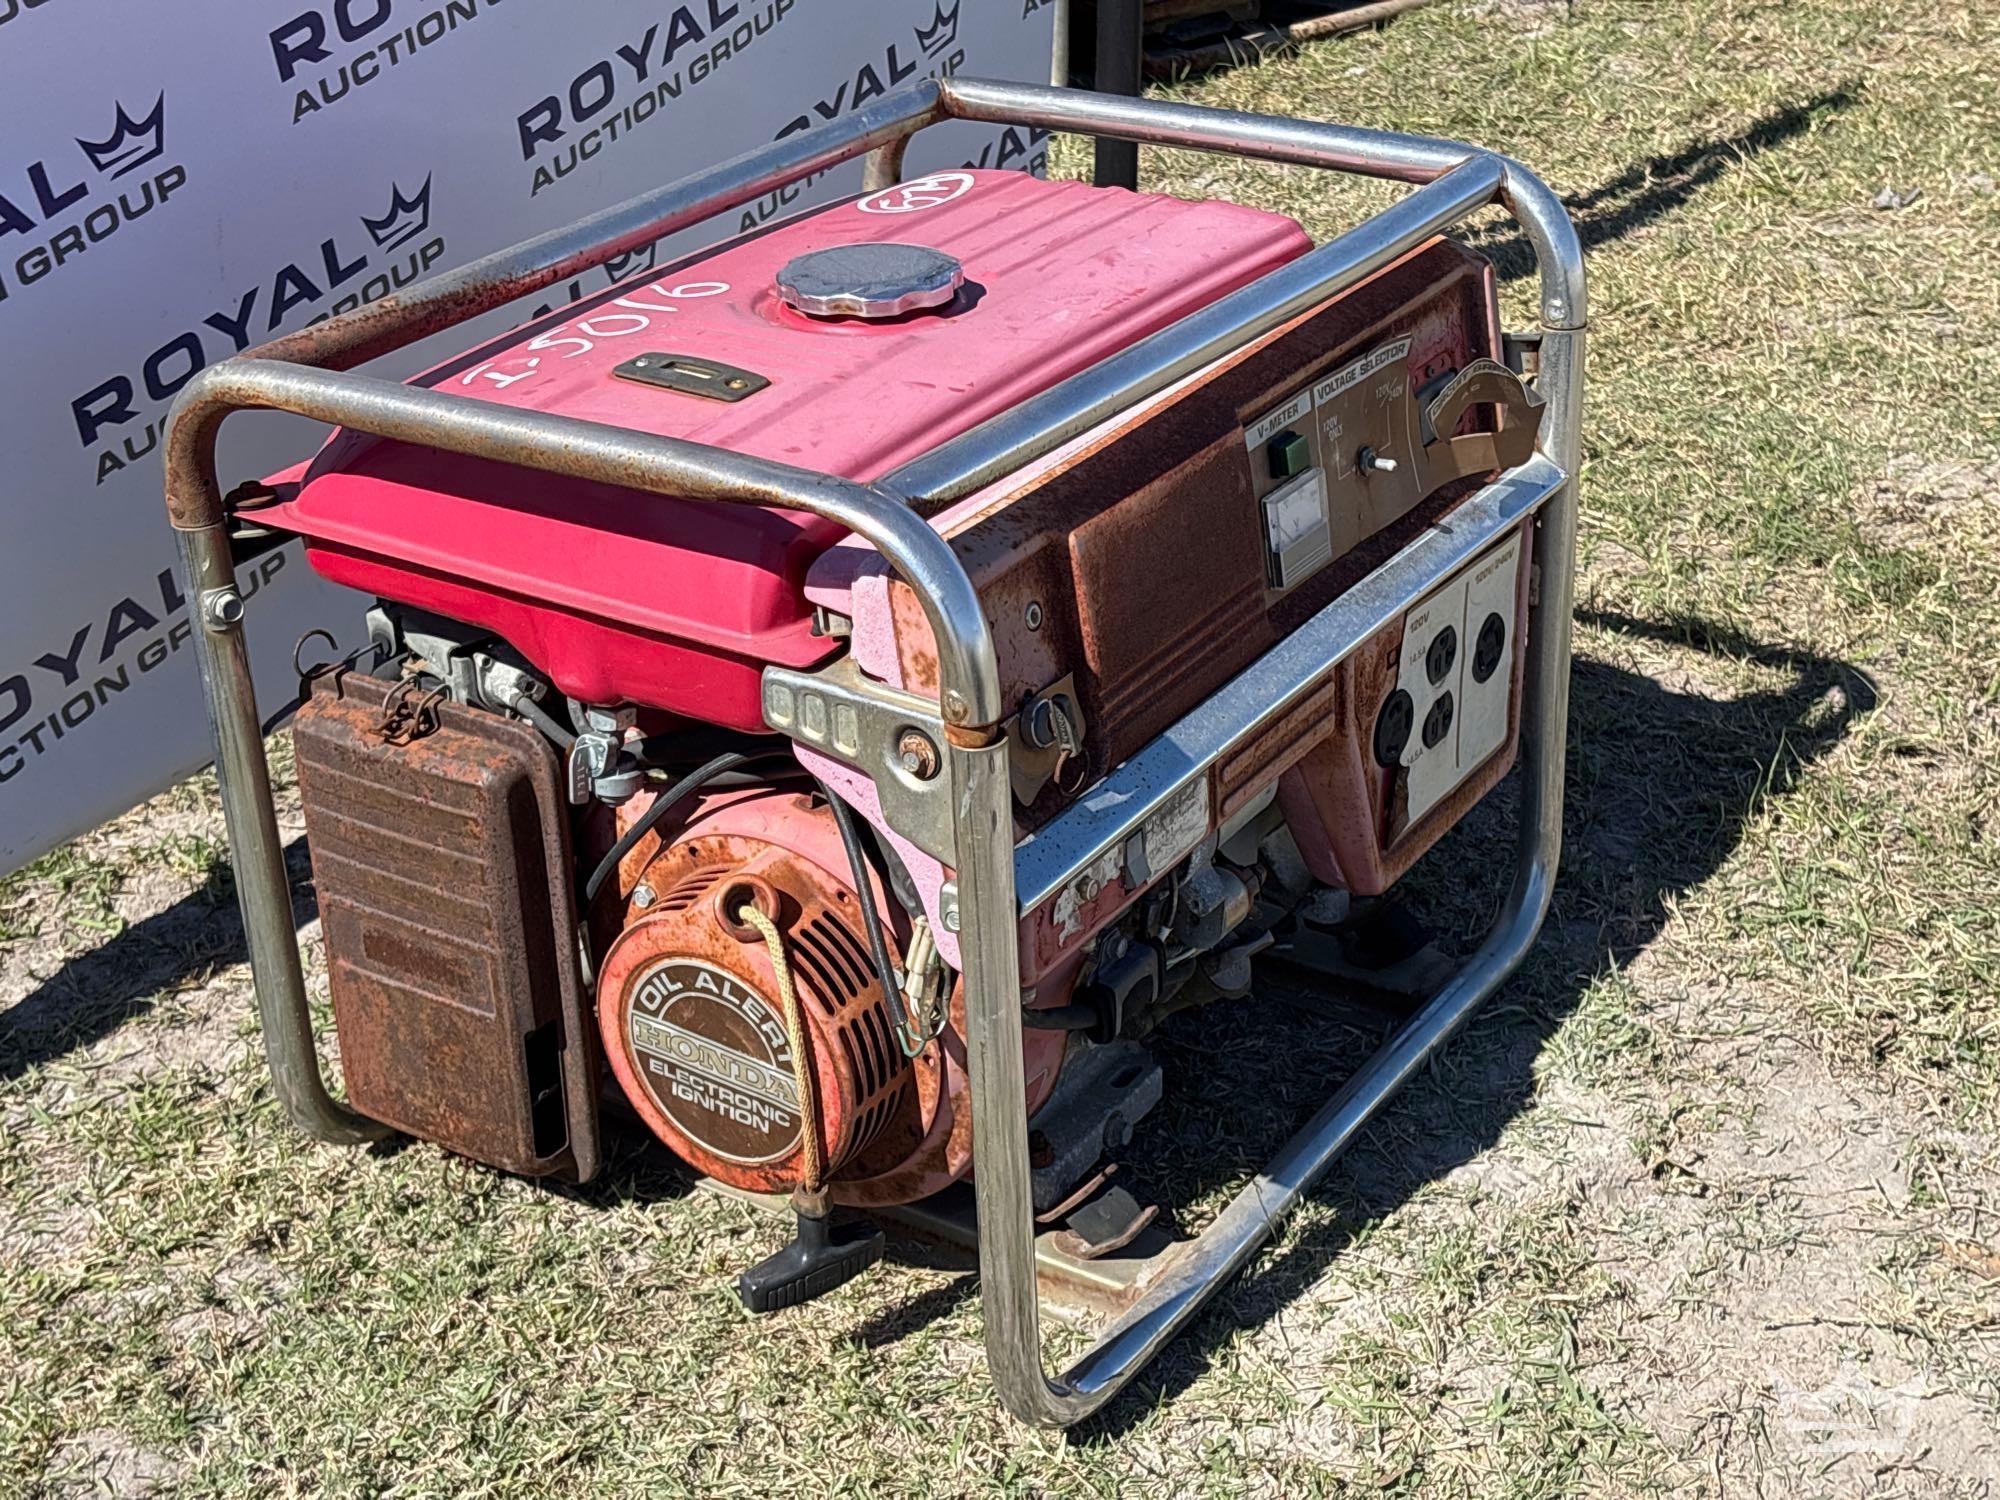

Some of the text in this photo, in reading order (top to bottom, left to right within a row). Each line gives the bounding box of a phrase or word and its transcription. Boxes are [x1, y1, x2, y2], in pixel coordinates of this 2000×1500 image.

[293, 0, 478, 125] AUCTION
[517, 0, 739, 161] ROYAL
[531, 0, 795, 198] AUCTION GROUP
[774, 44, 916, 140] YAL
[15, 165, 187, 286] GROUP
[71, 238, 368, 448] ROYAL
[1317, 343, 1406, 401] VOLTAGE SELECTOR
[1257, 403, 1299, 439] V-METER
[1322, 415, 1339, 433] 120V
[1328, 423, 1343, 442] ONLY
[137, 551, 286, 673] GRUP
[1409, 610, 1430, 633] 120V
[639, 971, 793, 1062] OIL ALERT
[635, 1020, 799, 1105] HONDA
[650, 1057, 791, 1128] ELECTRONIC
[671, 1081, 770, 1135] IGNITION
